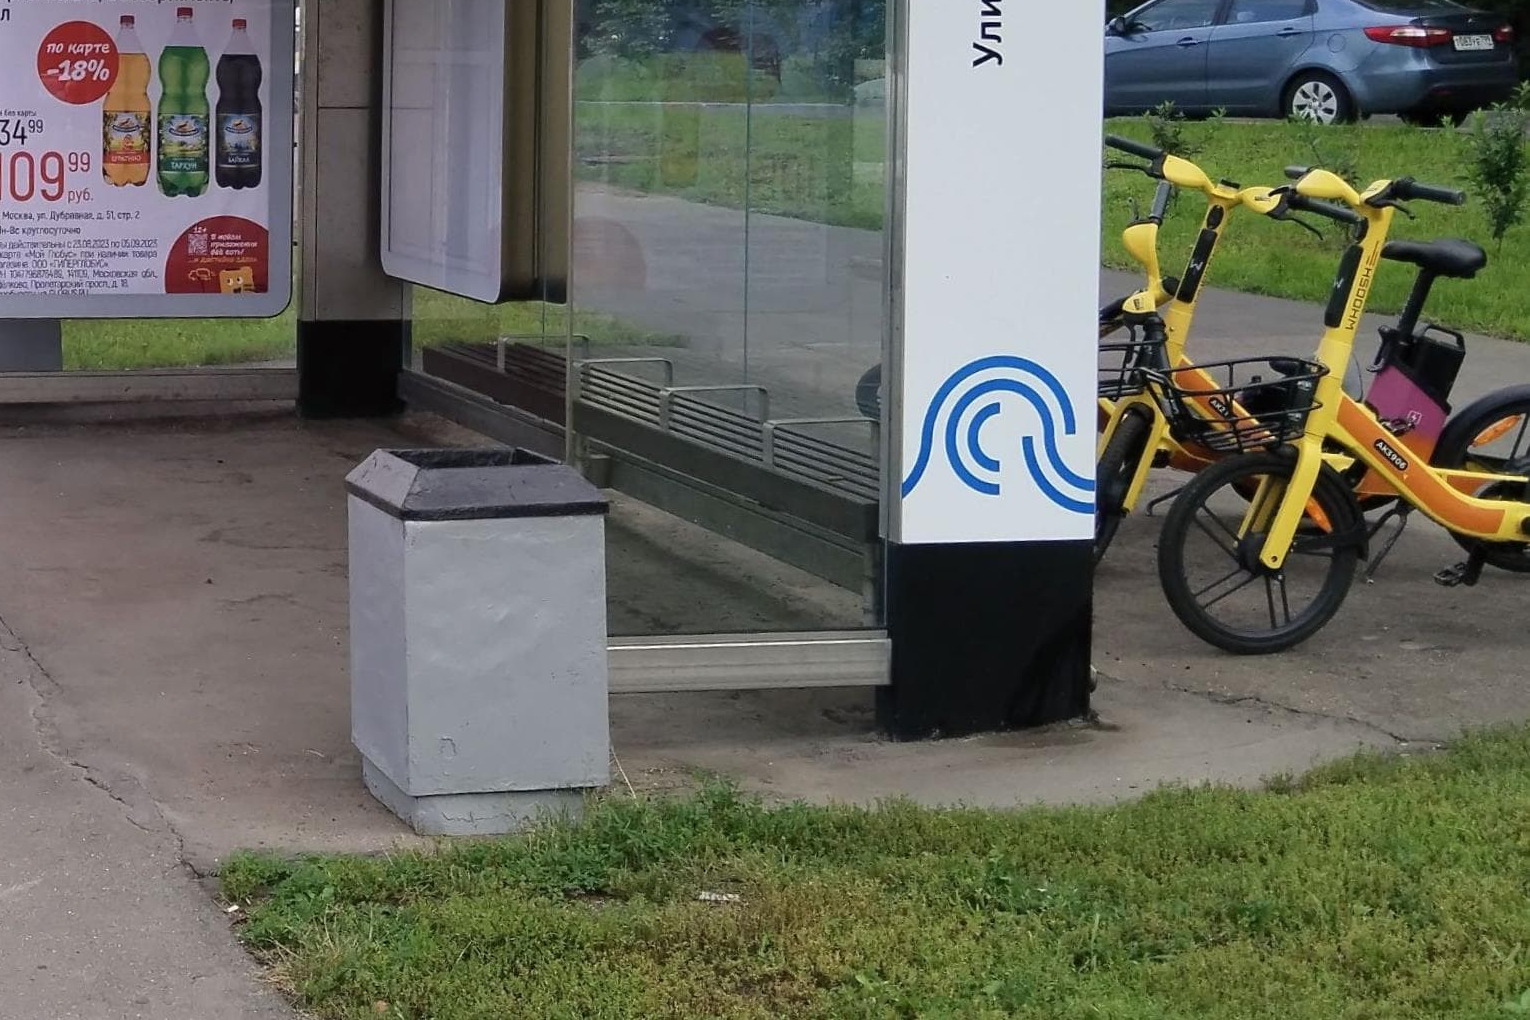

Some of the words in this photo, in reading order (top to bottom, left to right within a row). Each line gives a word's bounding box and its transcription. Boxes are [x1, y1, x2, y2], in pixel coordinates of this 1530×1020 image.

[0, 8, 10, 21] л
[46, 43, 63, 53] по
[68, 43, 110, 55] карте
[47, 59, 110, 81] -18%
[28, 119, 43, 133] 99
[68, 152, 90, 172] 99
[68, 188, 94, 204] руб.
[134, 211, 140, 219] 2
[22, 227, 81, 236] круглосуточно
[1345, 267, 1373, 331] WHOOSH
